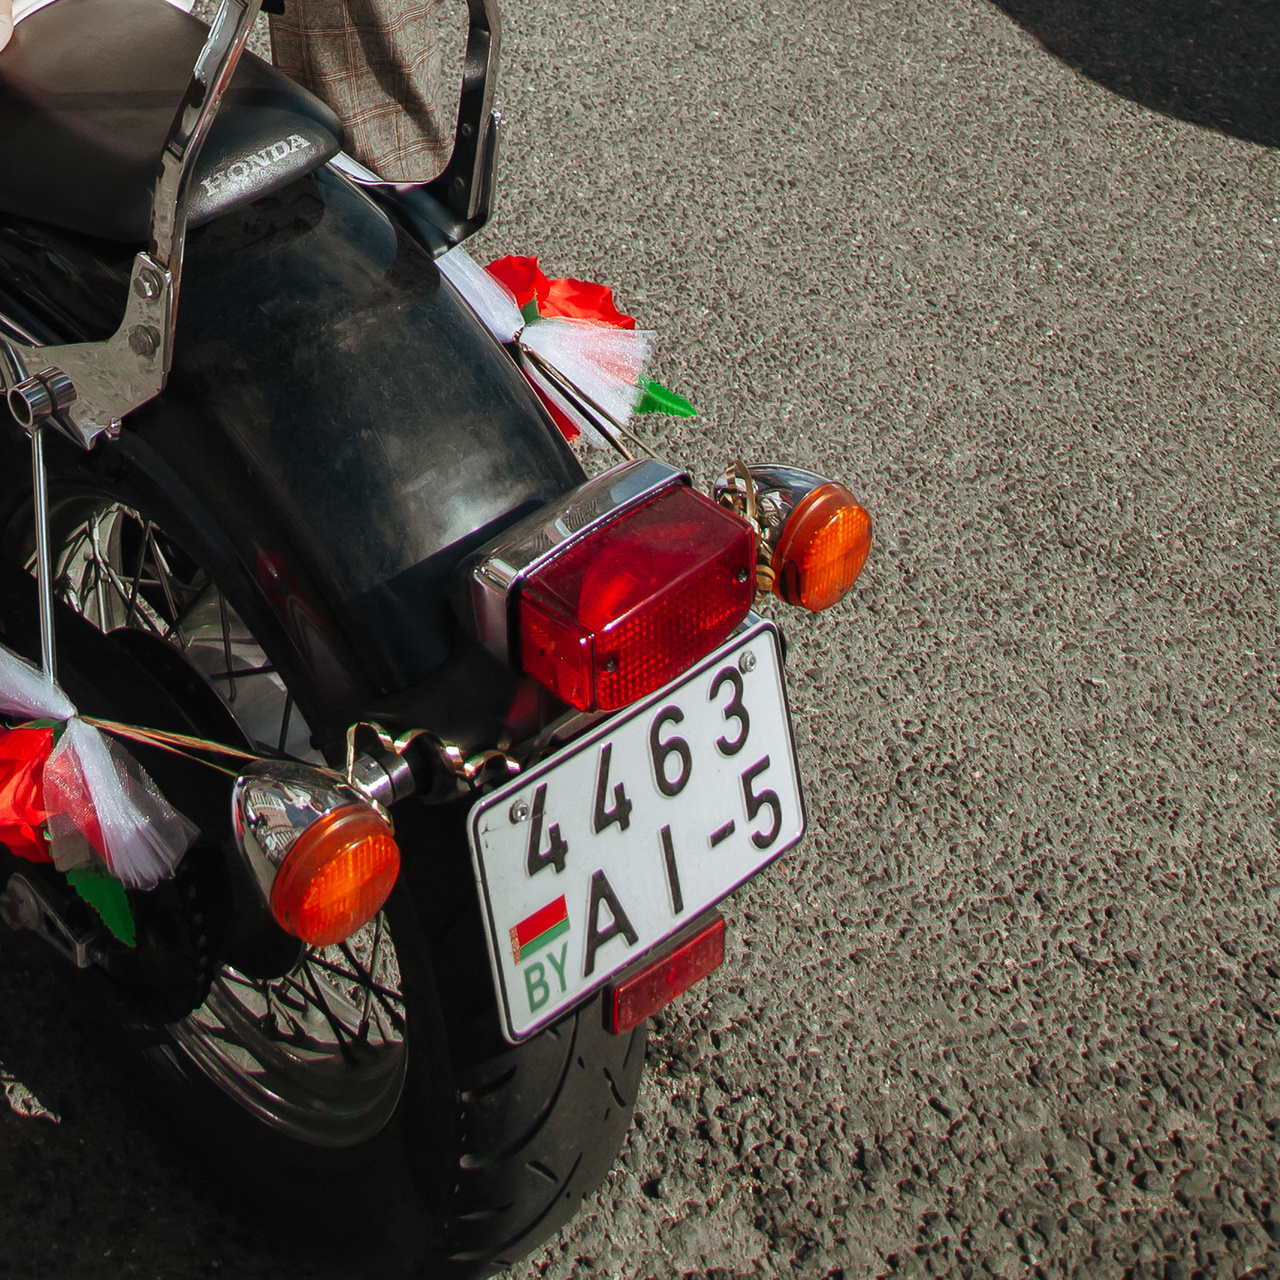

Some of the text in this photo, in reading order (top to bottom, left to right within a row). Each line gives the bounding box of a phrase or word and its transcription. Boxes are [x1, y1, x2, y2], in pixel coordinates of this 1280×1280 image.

[200, 133, 311, 197] HONDA
[526, 664, 751, 877] 4463
[523, 942, 569, 1014] BY
